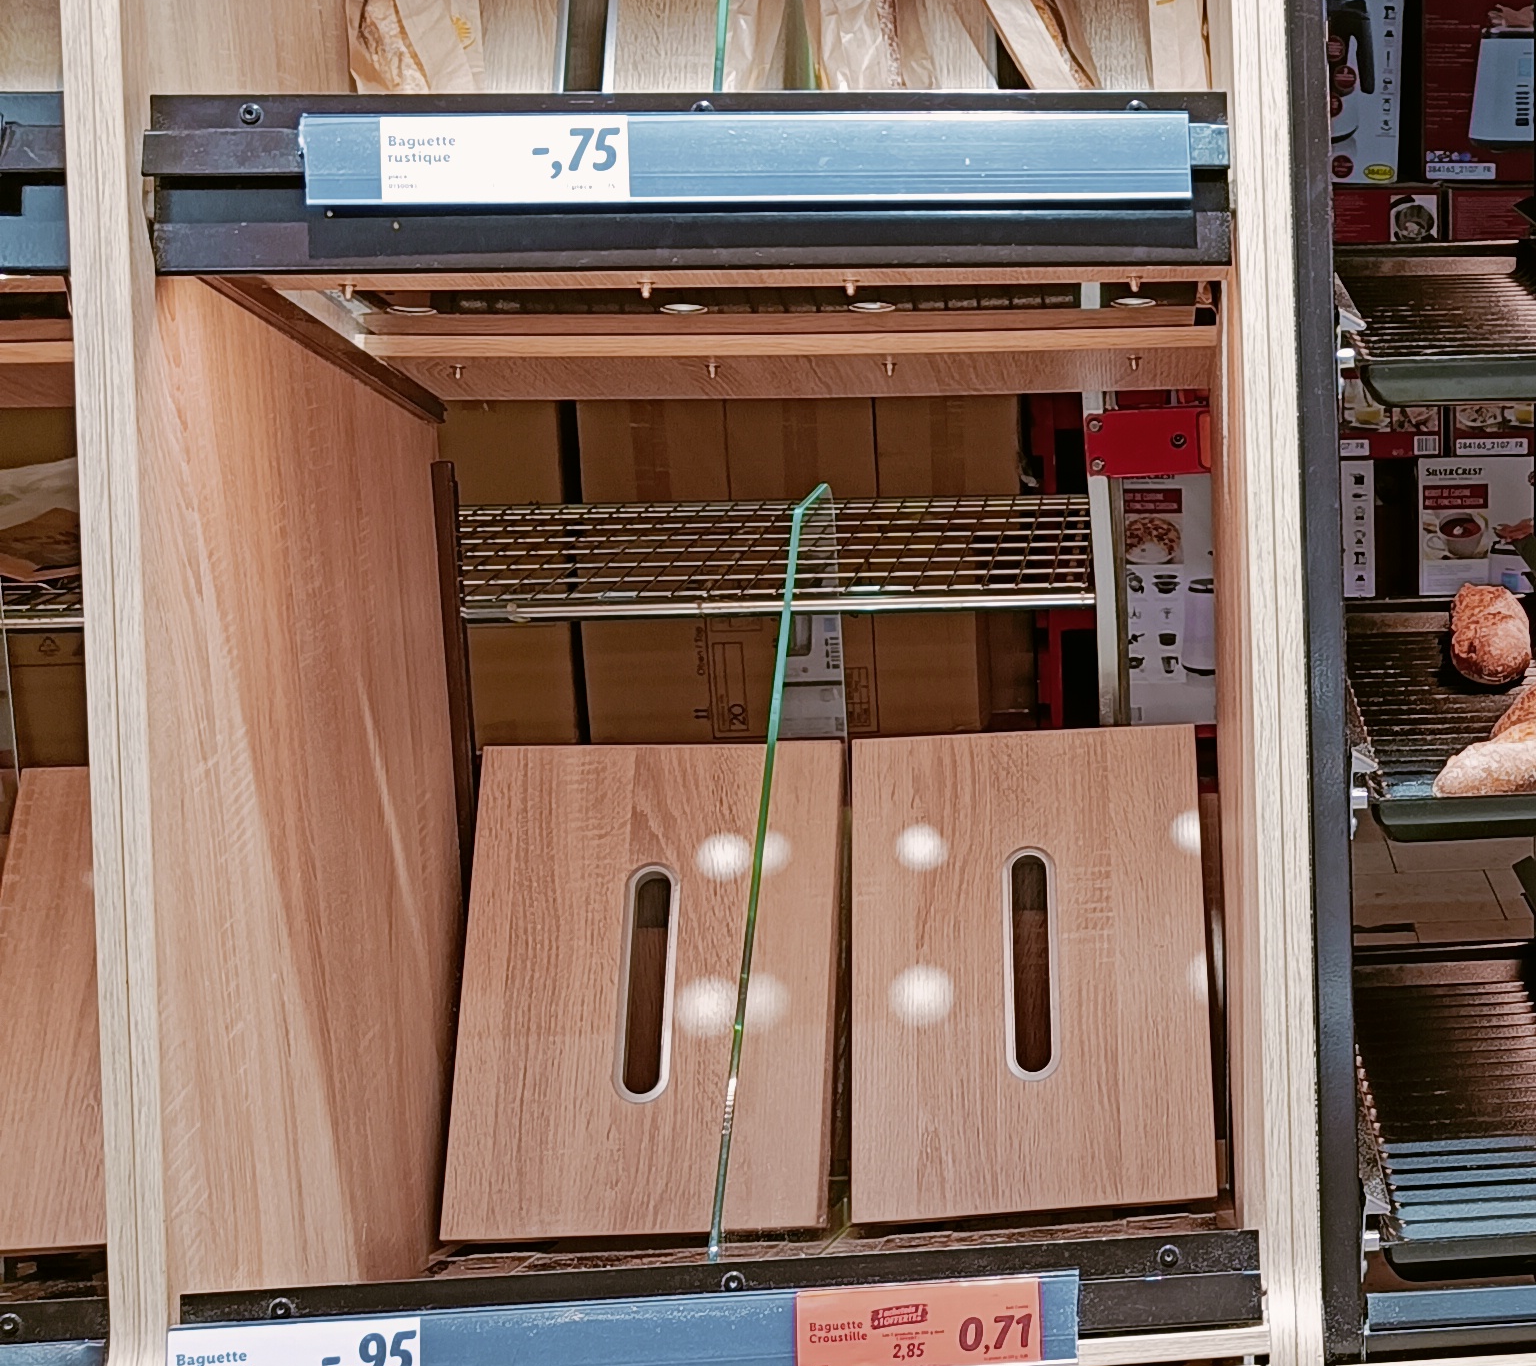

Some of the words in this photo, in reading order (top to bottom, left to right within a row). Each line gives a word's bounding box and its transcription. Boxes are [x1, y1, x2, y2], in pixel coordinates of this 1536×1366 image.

[388, 135, 456, 150] Baguette
[387, 151, 451, 166] rustique
[532, 126, 621, 179] -,75
[730, 703, 747, 726] 20
[809, 1321, 863, 1334] Baguette
[958, 1313, 1033, 1355] 0,71
[809, 1331, 868, 1344] Croustille
[892, 1342, 926, 1361] 2,85
